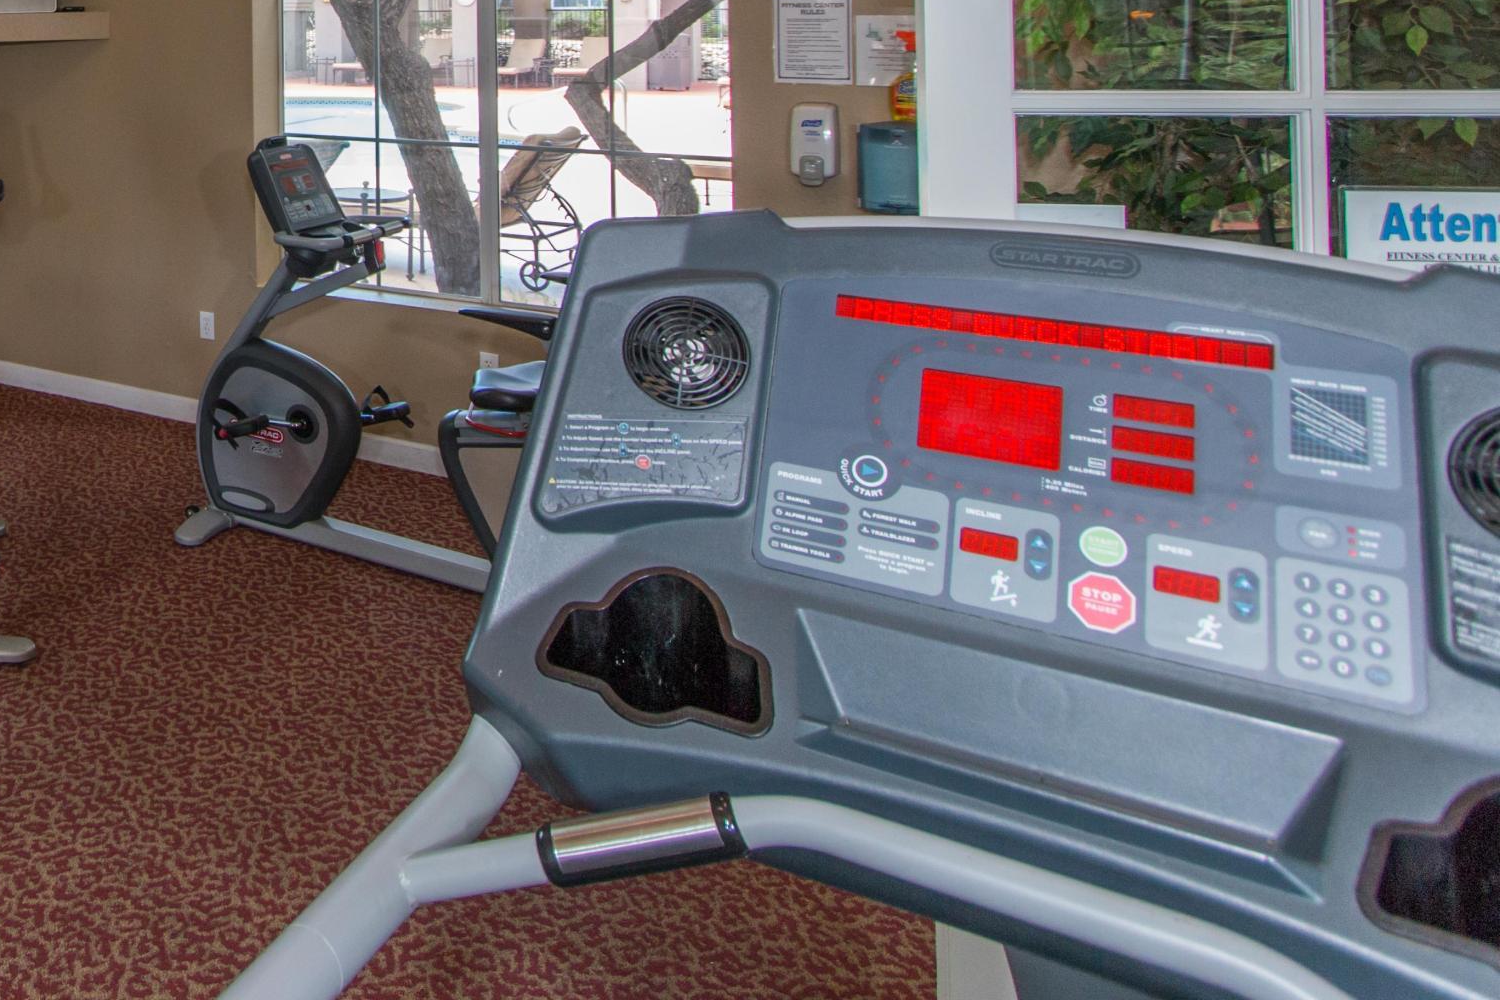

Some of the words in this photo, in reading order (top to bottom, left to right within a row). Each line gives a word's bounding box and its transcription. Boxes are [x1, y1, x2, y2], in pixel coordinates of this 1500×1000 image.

[1379, 202, 1500, 242] Atten
[1000, 250, 1058, 265] STAR
[1062, 254, 1126, 271] TRAC
[1387, 251, 1435, 260] FITNESS
[1438, 253, 1486, 261] CENTER
[1490, 254, 1499, 262] &
[855, 298, 951, 330] PRESS
[974, 312, 1079, 347] QUICK
[1103, 327, 1221, 363] START
[1088, 406, 1108, 414] TIME
[1069, 434, 1107, 445] DISTANCE
[777, 470, 822, 485] PROGRAMS
[840, 458, 853, 486] QUICK
[853, 485, 883, 497] START
[1068, 465, 1107, 476] CALORIES
[786, 495, 811, 505] MANUAL
[784, 511, 806, 520] ALPINE
[872, 512, 897, 522] FOREST
[898, 518, 917, 526] WALK
[965, 507, 1002, 520] INCLINE
[870, 528, 916, 543] TRAILBLAZER
[780, 543, 808, 554] TRAINING
[809, 548, 830, 559] TOOLS
[879, 550, 900, 559] QUICK
[902, 555, 924, 564] START
[1157, 543, 1193, 557] SPEED
[897, 562, 926, 571] program
[1080, 586, 1122, 603] STOP
[1302, 576, 1311, 589] 1
[1335, 582, 1348, 596] 2
[1368, 589, 1381, 603] 3
[1084, 602, 1119, 616] PAUSE
[1302, 602, 1314, 615] 4
[1335, 608, 1348, 621] 5
[1369, 615, 1383, 629] 6
[1302, 627, 1314, 640] 7
[1336, 634, 1349, 648] 8
[1336, 661, 1350, 675] 0
